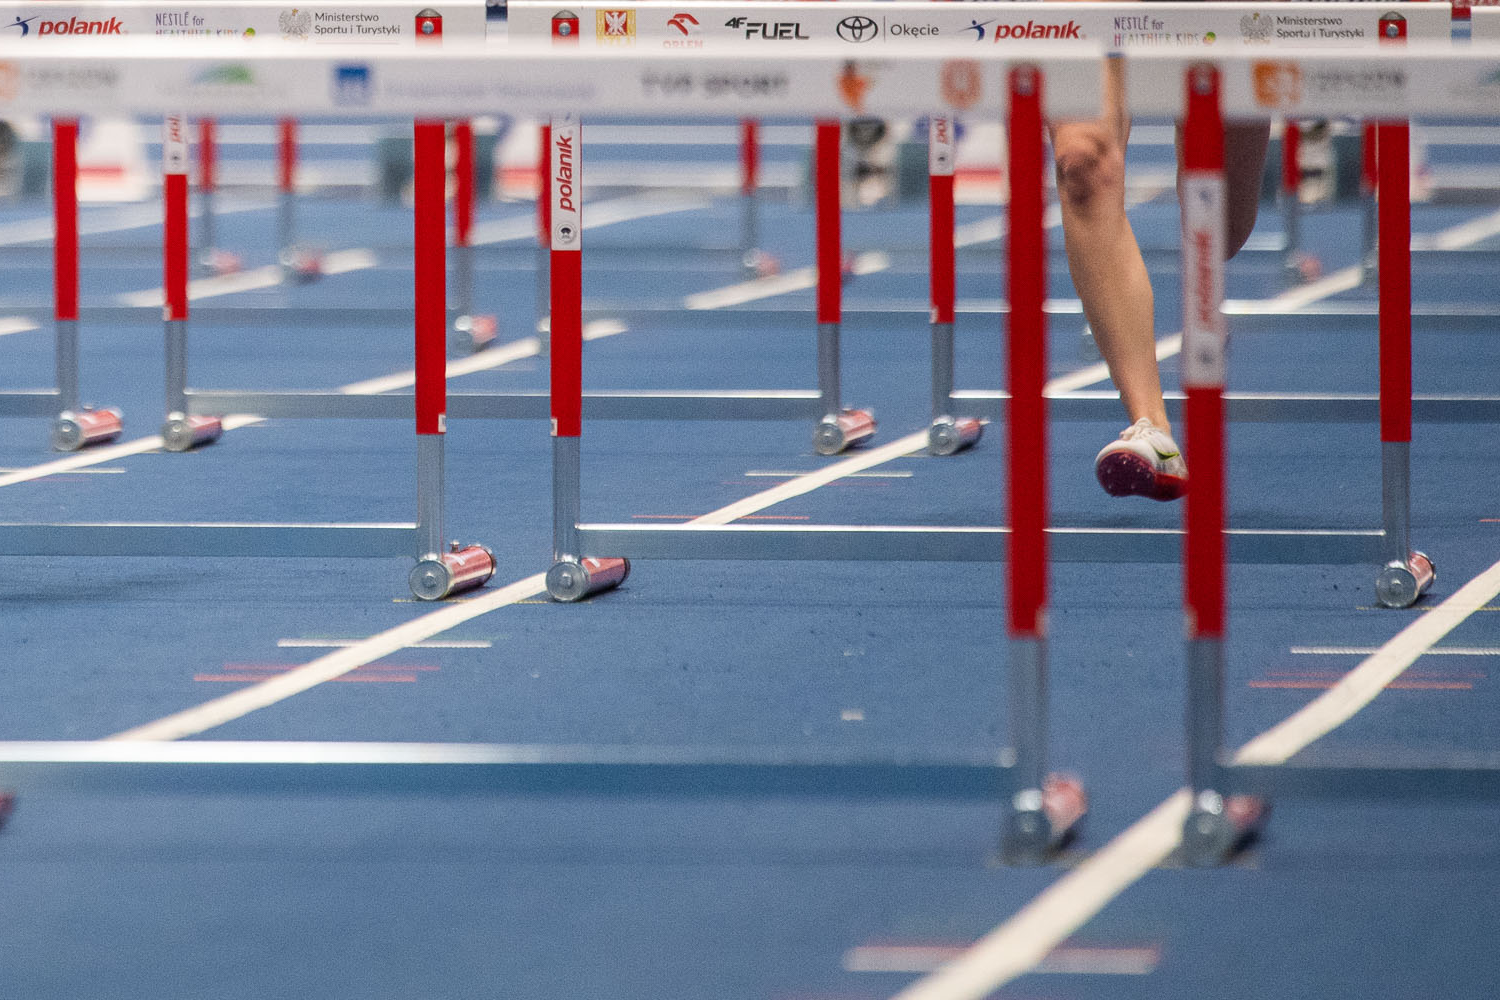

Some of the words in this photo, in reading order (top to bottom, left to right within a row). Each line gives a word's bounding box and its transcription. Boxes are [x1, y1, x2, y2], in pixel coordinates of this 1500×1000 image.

[155, 11, 189, 26] NESTLÉ
[192, 15, 205, 26] for
[314, 12, 380, 22] Ministerstwo
[1113, 15, 1149, 30] NESTLÉ
[1152, 19, 1165, 30] for
[1276, 16, 1343, 26] Ministerstwo
[37, 16, 125, 39] polanik
[314, 25, 349, 36] Sportu
[350, 25, 354, 34] i
[357, 25, 401, 36] Turystyki
[745, 22, 810, 40] FUEL
[890, 24, 940, 39] Okęcie
[994, 20, 1081, 43] polanik
[1276, 28, 1311, 40] Sportu
[1312, 28, 1316, 38] i
[1319, 28, 1365, 40] Turystyki
[555, 135, 576, 213] polanik
